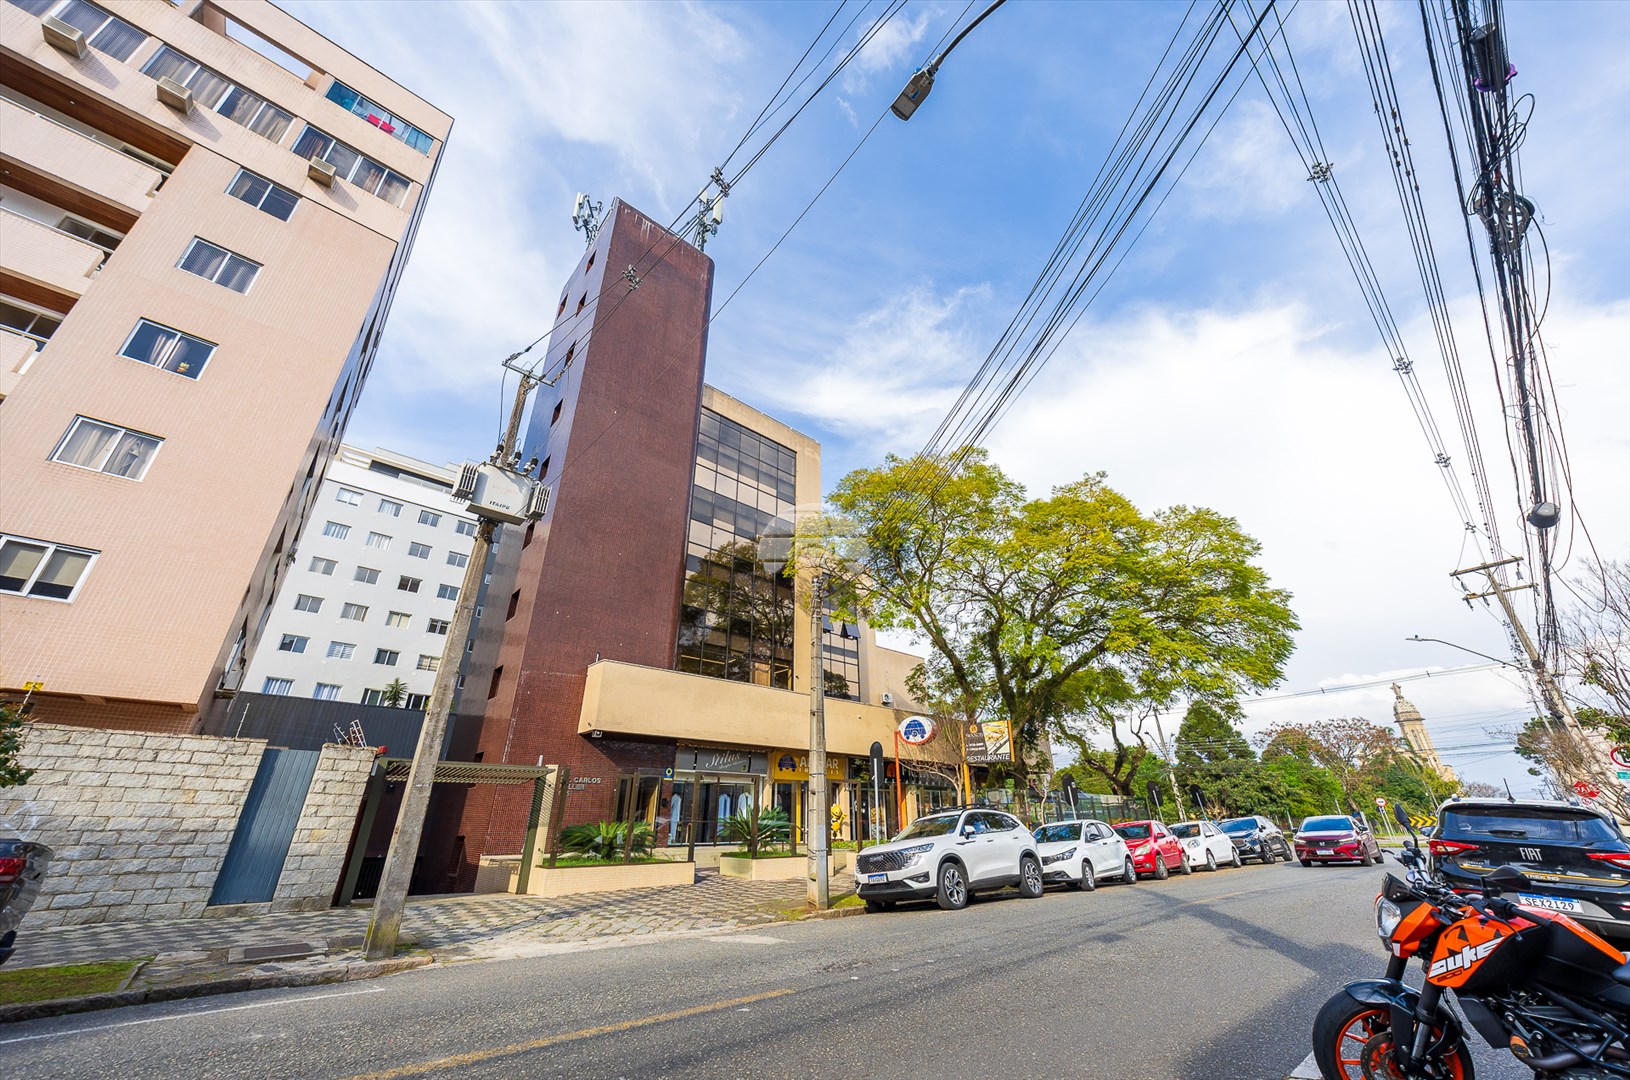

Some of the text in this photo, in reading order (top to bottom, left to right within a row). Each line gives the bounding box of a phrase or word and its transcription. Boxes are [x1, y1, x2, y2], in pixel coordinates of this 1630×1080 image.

[489, 500, 510, 509] ITAIPU
[573, 776, 602, 784] CARLOS
[1519, 847, 1543, 861] FIAT
[1525, 897, 1575, 911] SEX2129
